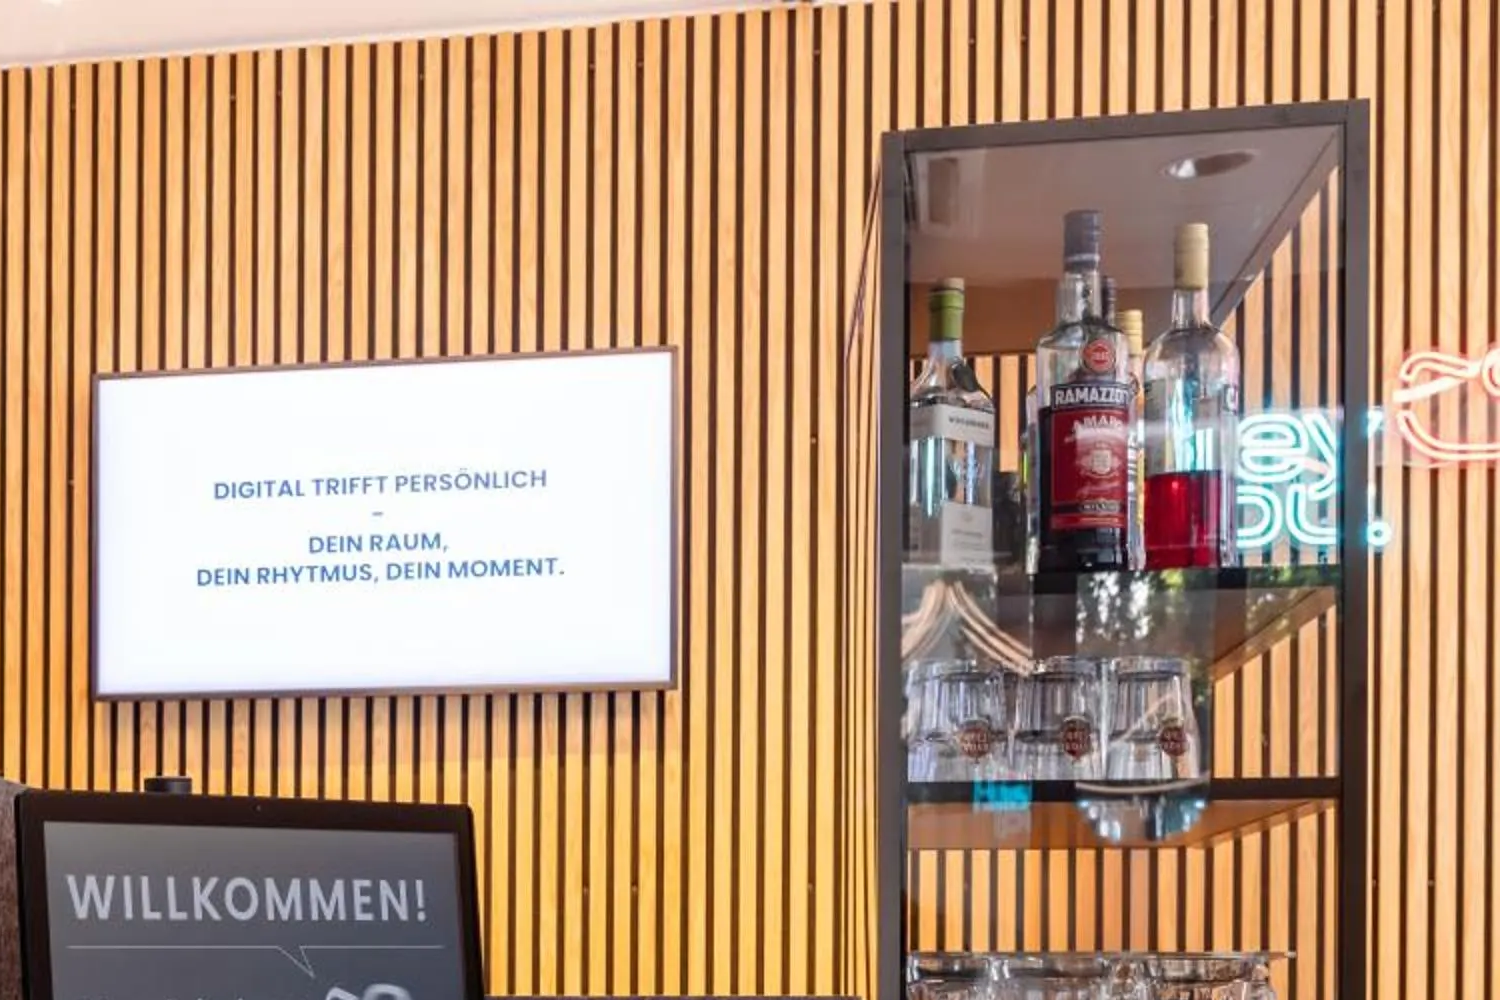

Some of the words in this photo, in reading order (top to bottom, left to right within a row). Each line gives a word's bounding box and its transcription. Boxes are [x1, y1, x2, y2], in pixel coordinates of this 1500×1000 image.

[213, 478, 305, 500] DIGITAL
[311, 474, 389, 496] TRIFFT
[395, 467, 547, 493] PERSÖNLICH
[307, 534, 363, 555] DEIN
[369, 532, 449, 554] RAUM,
[196, 567, 250, 587] DEIN
[256, 563, 379, 585] RHYTMUS,
[386, 560, 441, 581] DEIN
[447, 556, 566, 580] MOMENT.
[65, 872, 427, 922] WILLKOMMEN!
